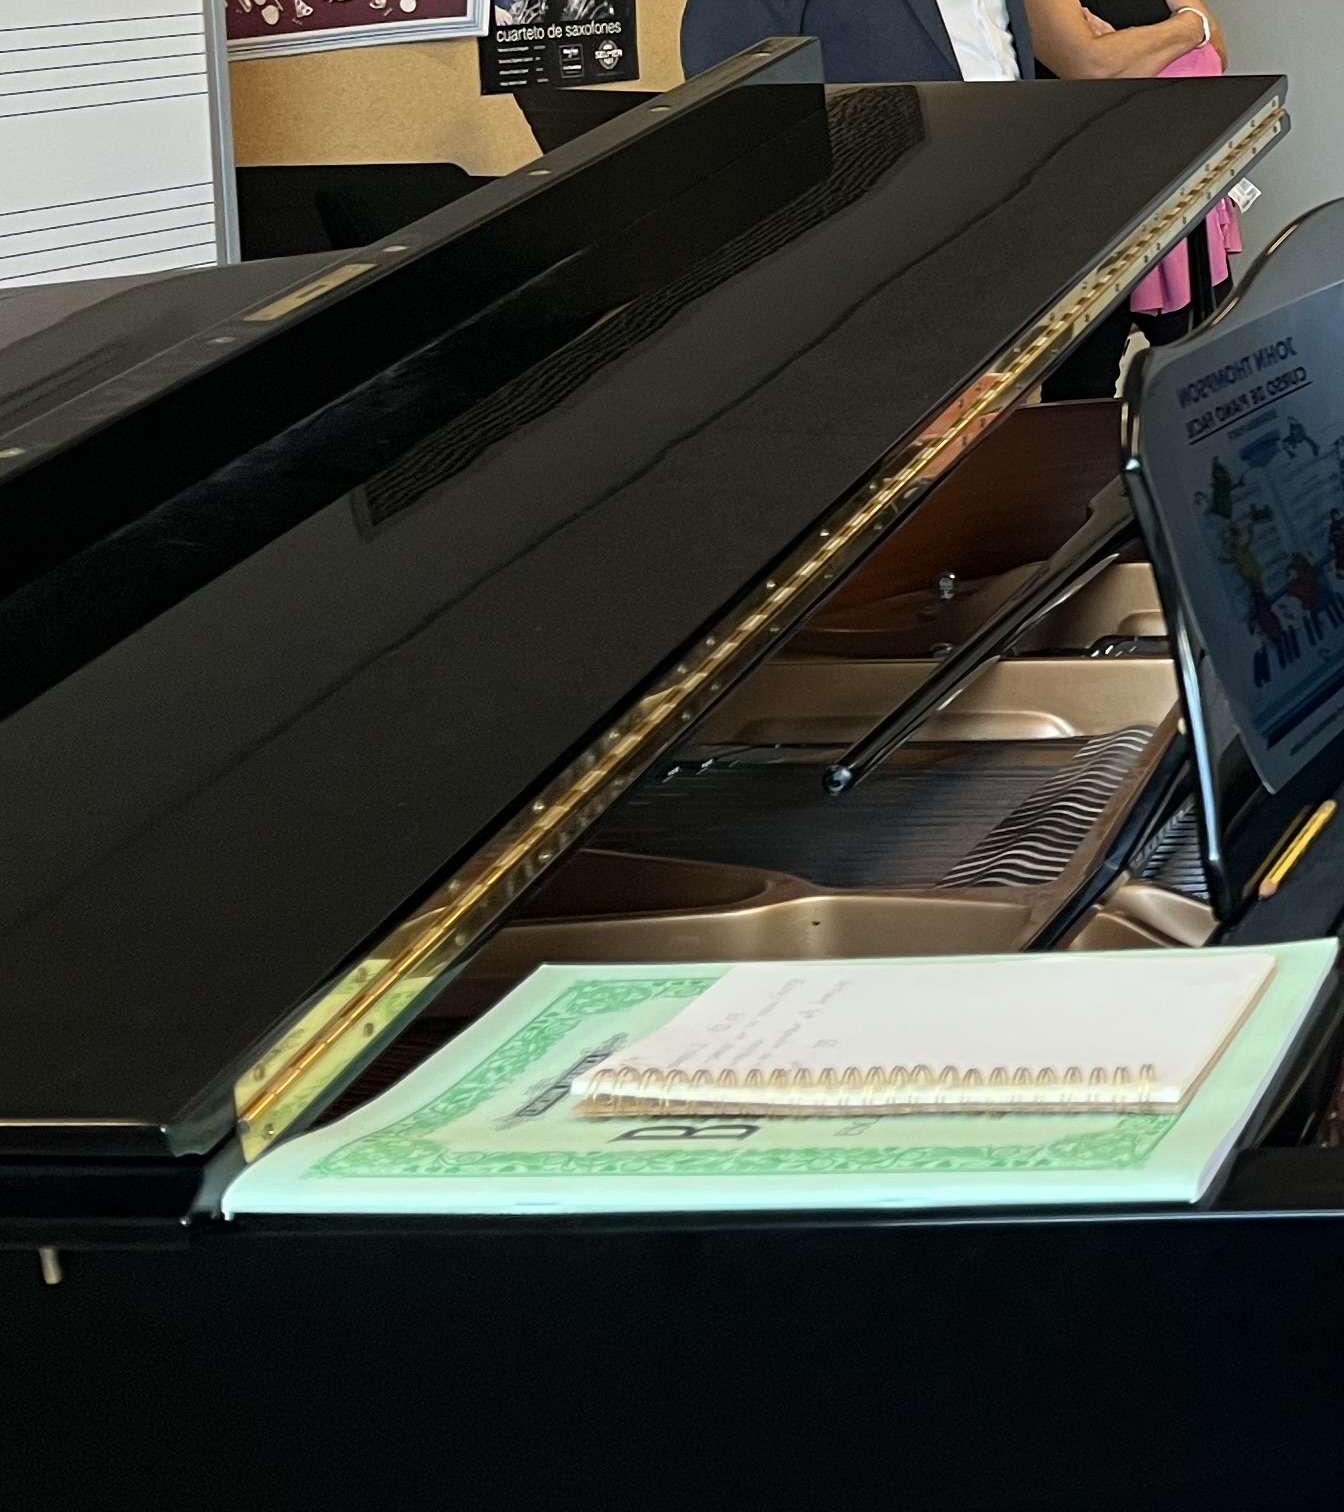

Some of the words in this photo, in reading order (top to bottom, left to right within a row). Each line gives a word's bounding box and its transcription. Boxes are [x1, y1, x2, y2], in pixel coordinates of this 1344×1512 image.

[496, 27, 545, 42] cuarteto
[547, 23, 563, 38] de
[565, 20, 622, 37] saxofones
